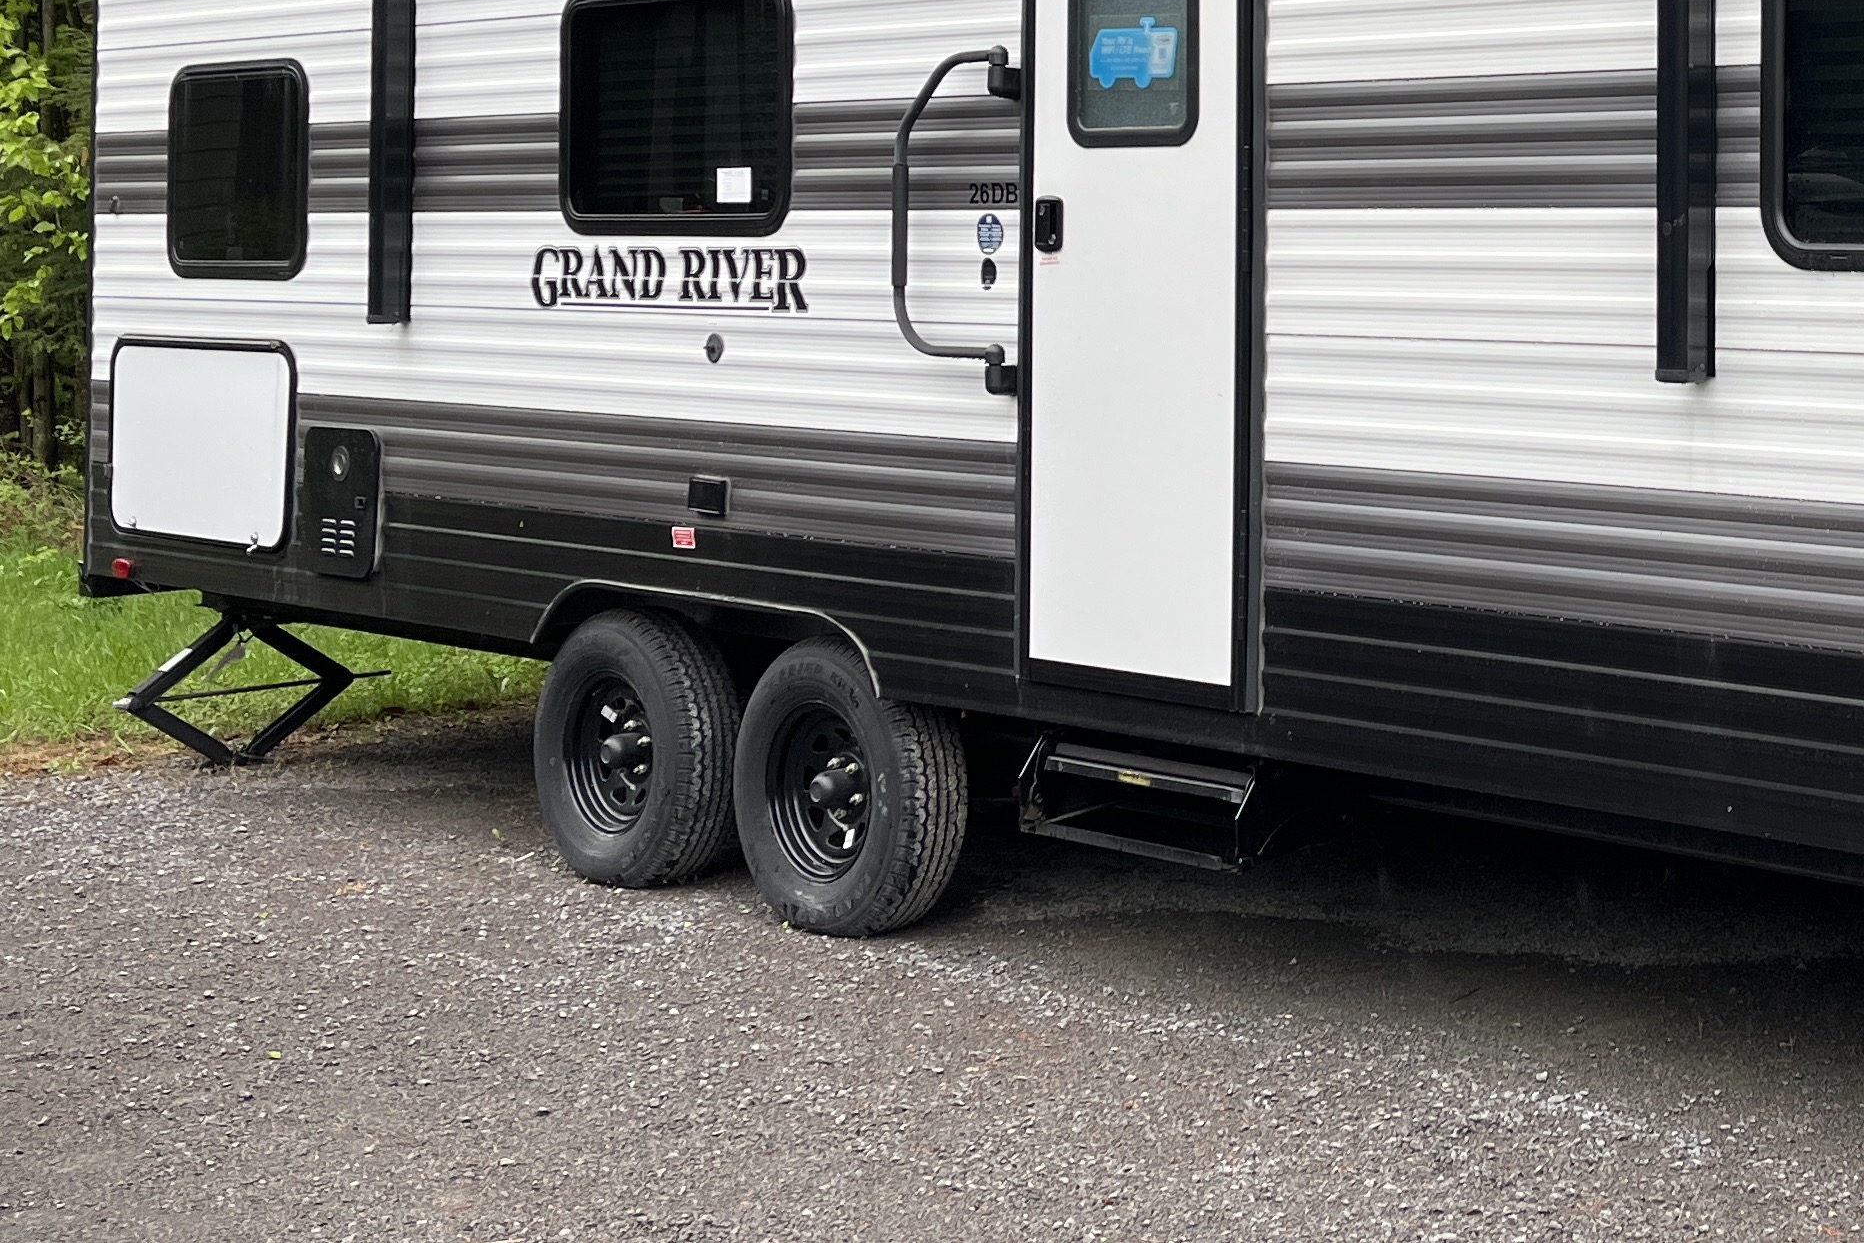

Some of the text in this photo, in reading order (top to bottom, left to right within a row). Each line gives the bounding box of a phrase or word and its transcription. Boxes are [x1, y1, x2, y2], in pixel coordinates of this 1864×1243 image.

[969, 183, 1018, 204] 26DB
[531, 245, 809, 313] GRAND RIVER
